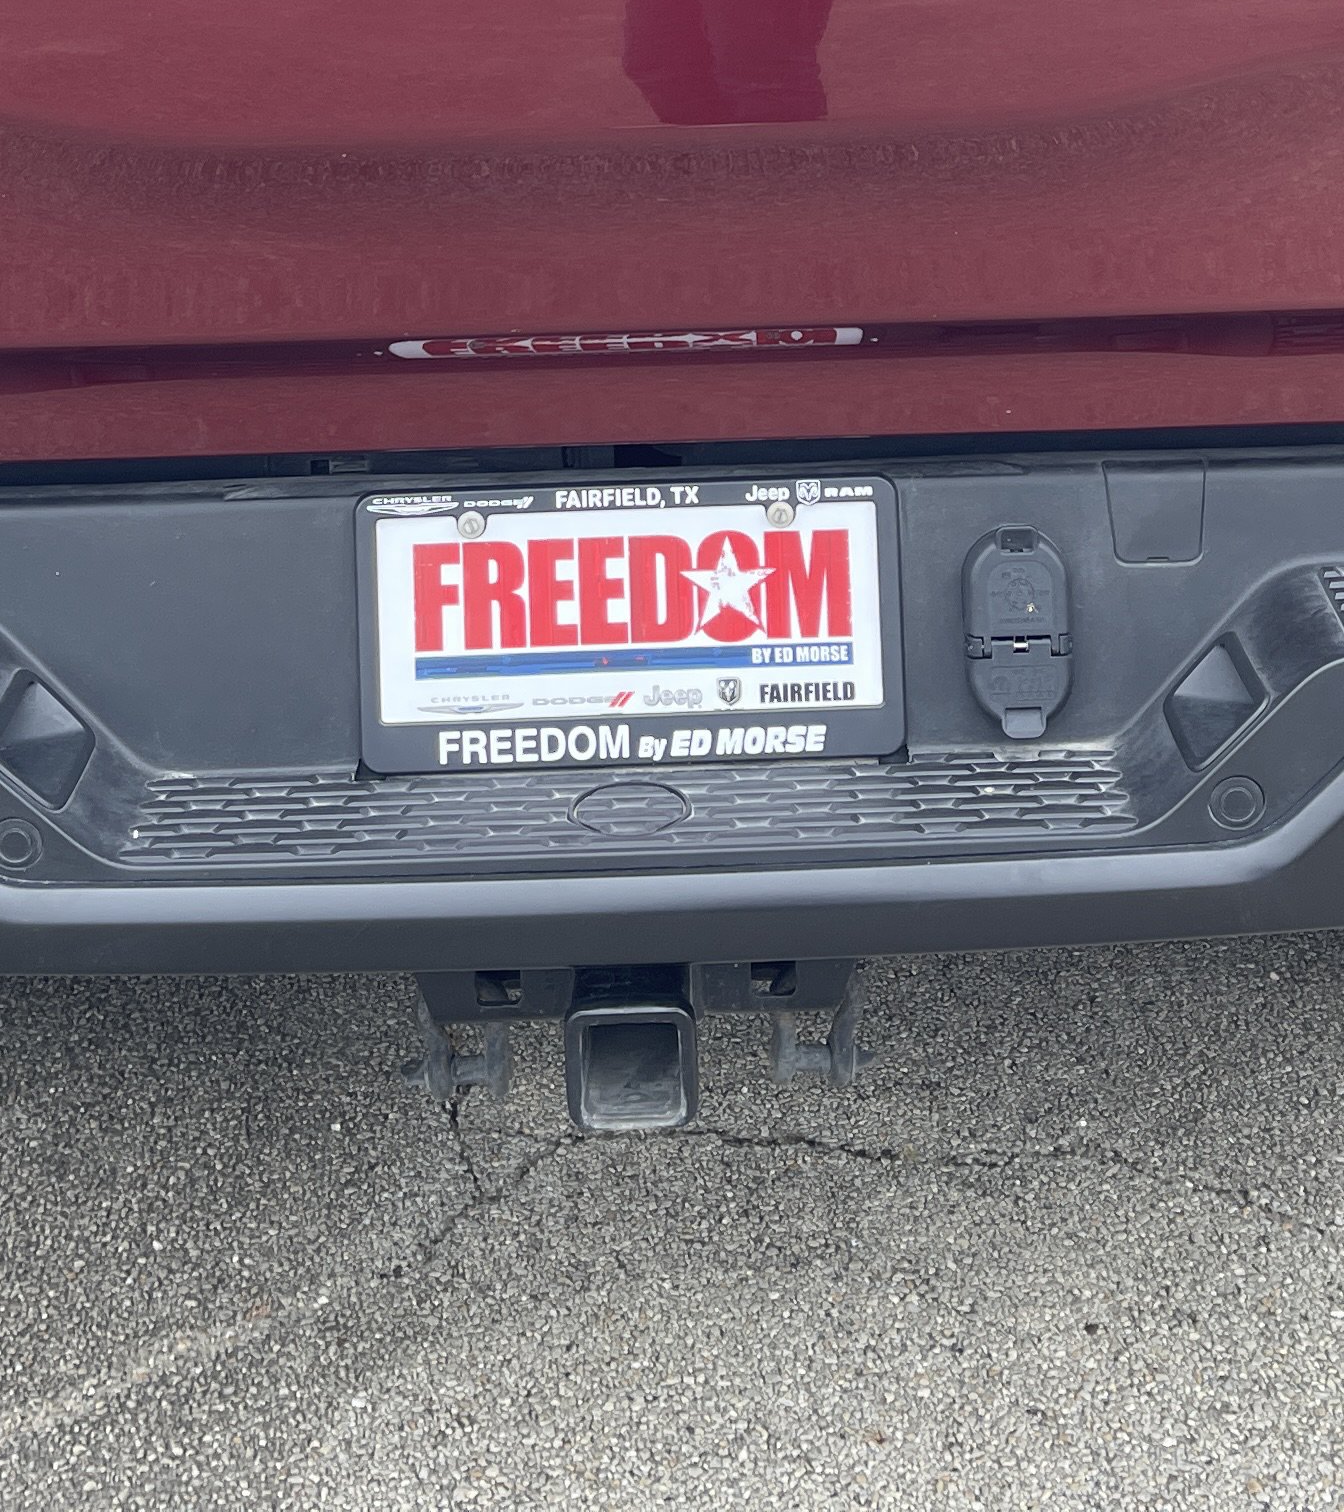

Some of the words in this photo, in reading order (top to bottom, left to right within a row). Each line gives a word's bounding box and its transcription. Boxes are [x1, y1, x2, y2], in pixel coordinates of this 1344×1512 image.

[372, 495, 453, 505] CHRYSLER
[555, 486, 665, 509] FAIRFIELD,
[670, 486, 699, 505] TX
[745, 485, 790, 502] Jeep
[824, 486, 873, 497] RAM
[412, 529, 854, 652] FREEDOM
[751, 646, 772, 664] BY
[774, 646, 793, 663] ED
[796, 645, 849, 663] MORSE
[430, 694, 510, 703] CHRYSLER
[643, 685, 702, 708] Jeep
[760, 681, 855, 704] FAIRFIELD
[439, 724, 630, 765] FREEDOM
[638, 735, 667, 761] By
[670, 728, 713, 757] ED
[716, 725, 827, 755] MORSE
